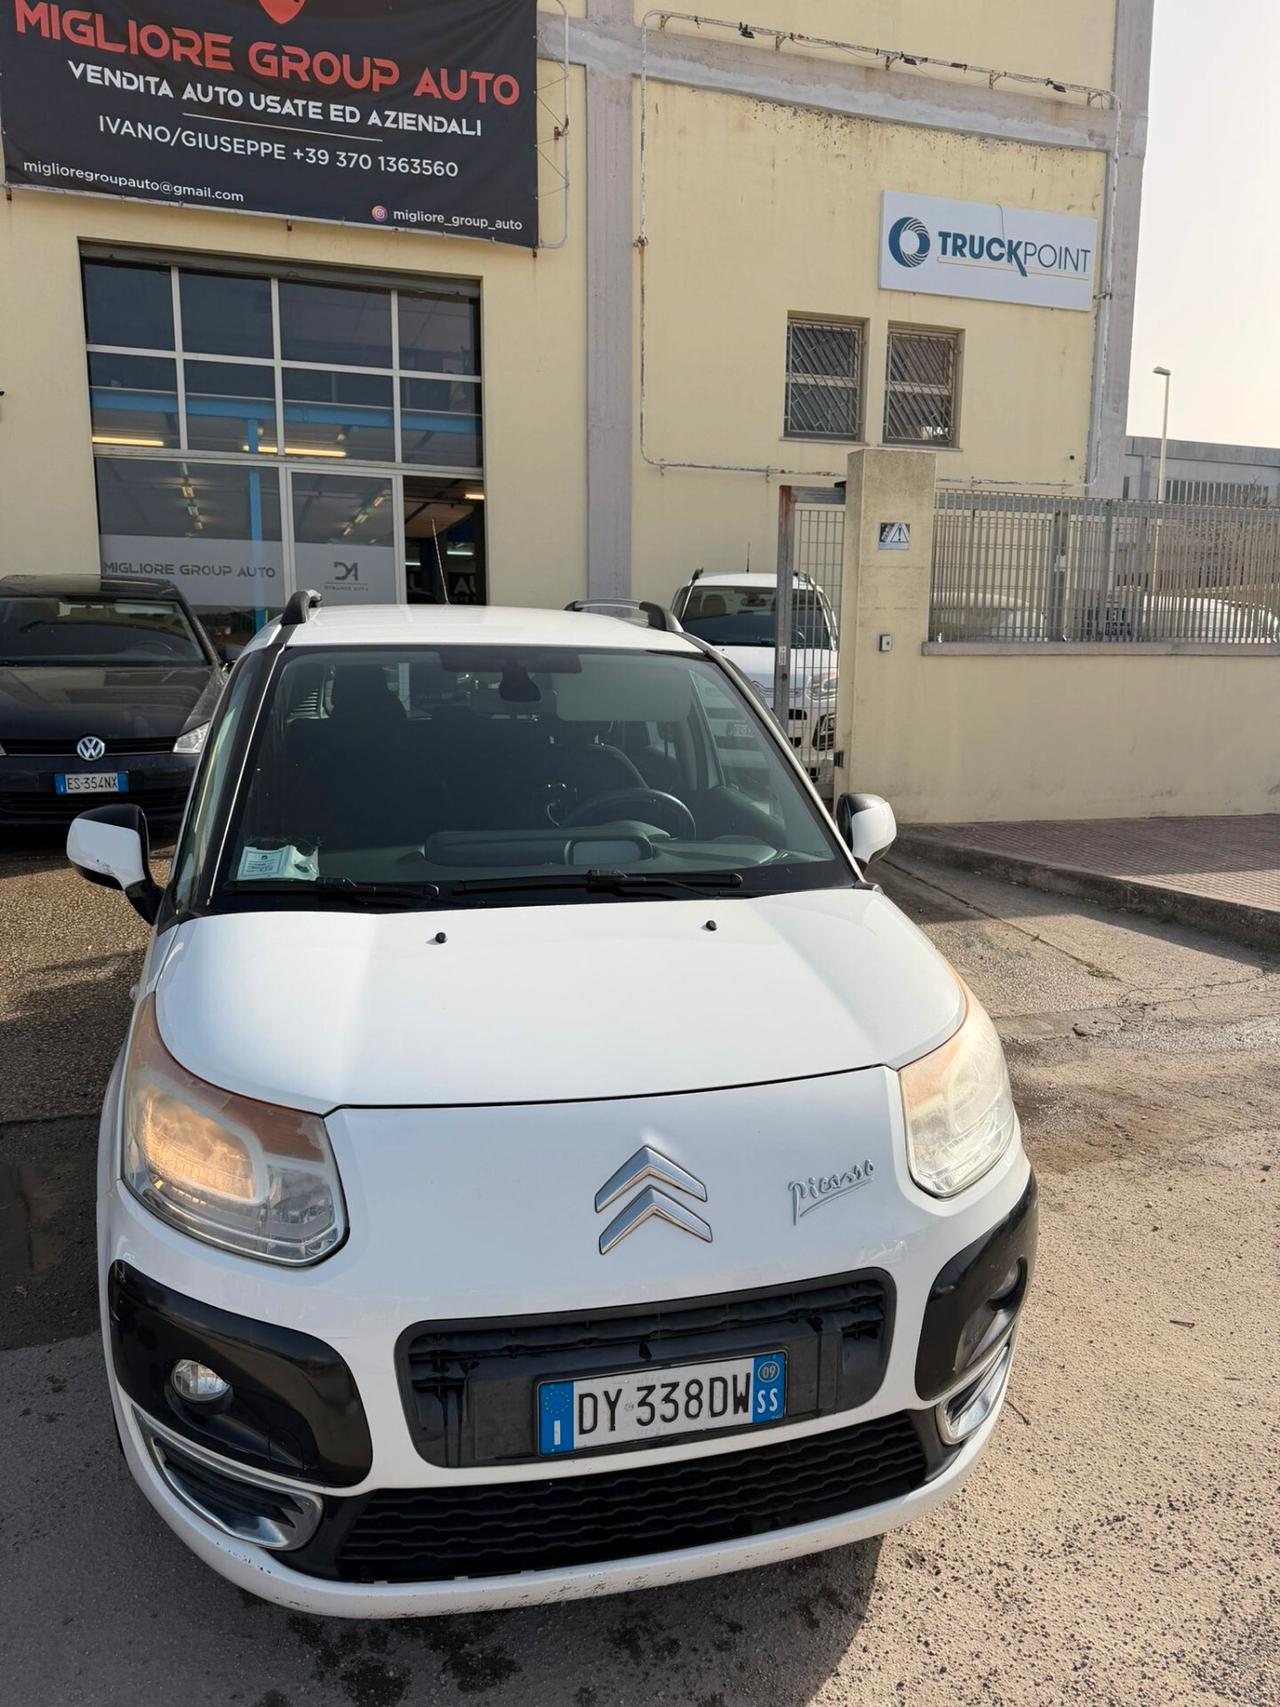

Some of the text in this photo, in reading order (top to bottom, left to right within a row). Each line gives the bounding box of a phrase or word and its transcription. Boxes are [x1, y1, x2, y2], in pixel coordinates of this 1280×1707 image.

[15, 0, 520, 106] MIGLIORE GROUP AUTO
[68, 60, 482, 137] VENDITA AUTO USATE ED AZIENDALI
[99, 115, 459, 178] IVANO/GIUSEPPE +39 370 1363560
[23, 160, 244, 202] miglioregroupauto@gmail.com
[393, 209, 523, 231] migliore_group_auto
[103, 562, 276, 579] MIGLIORE GROUP AUTO
[762, 1363, 776, 1378] 09
[757, 1388, 779, 1414] SS
